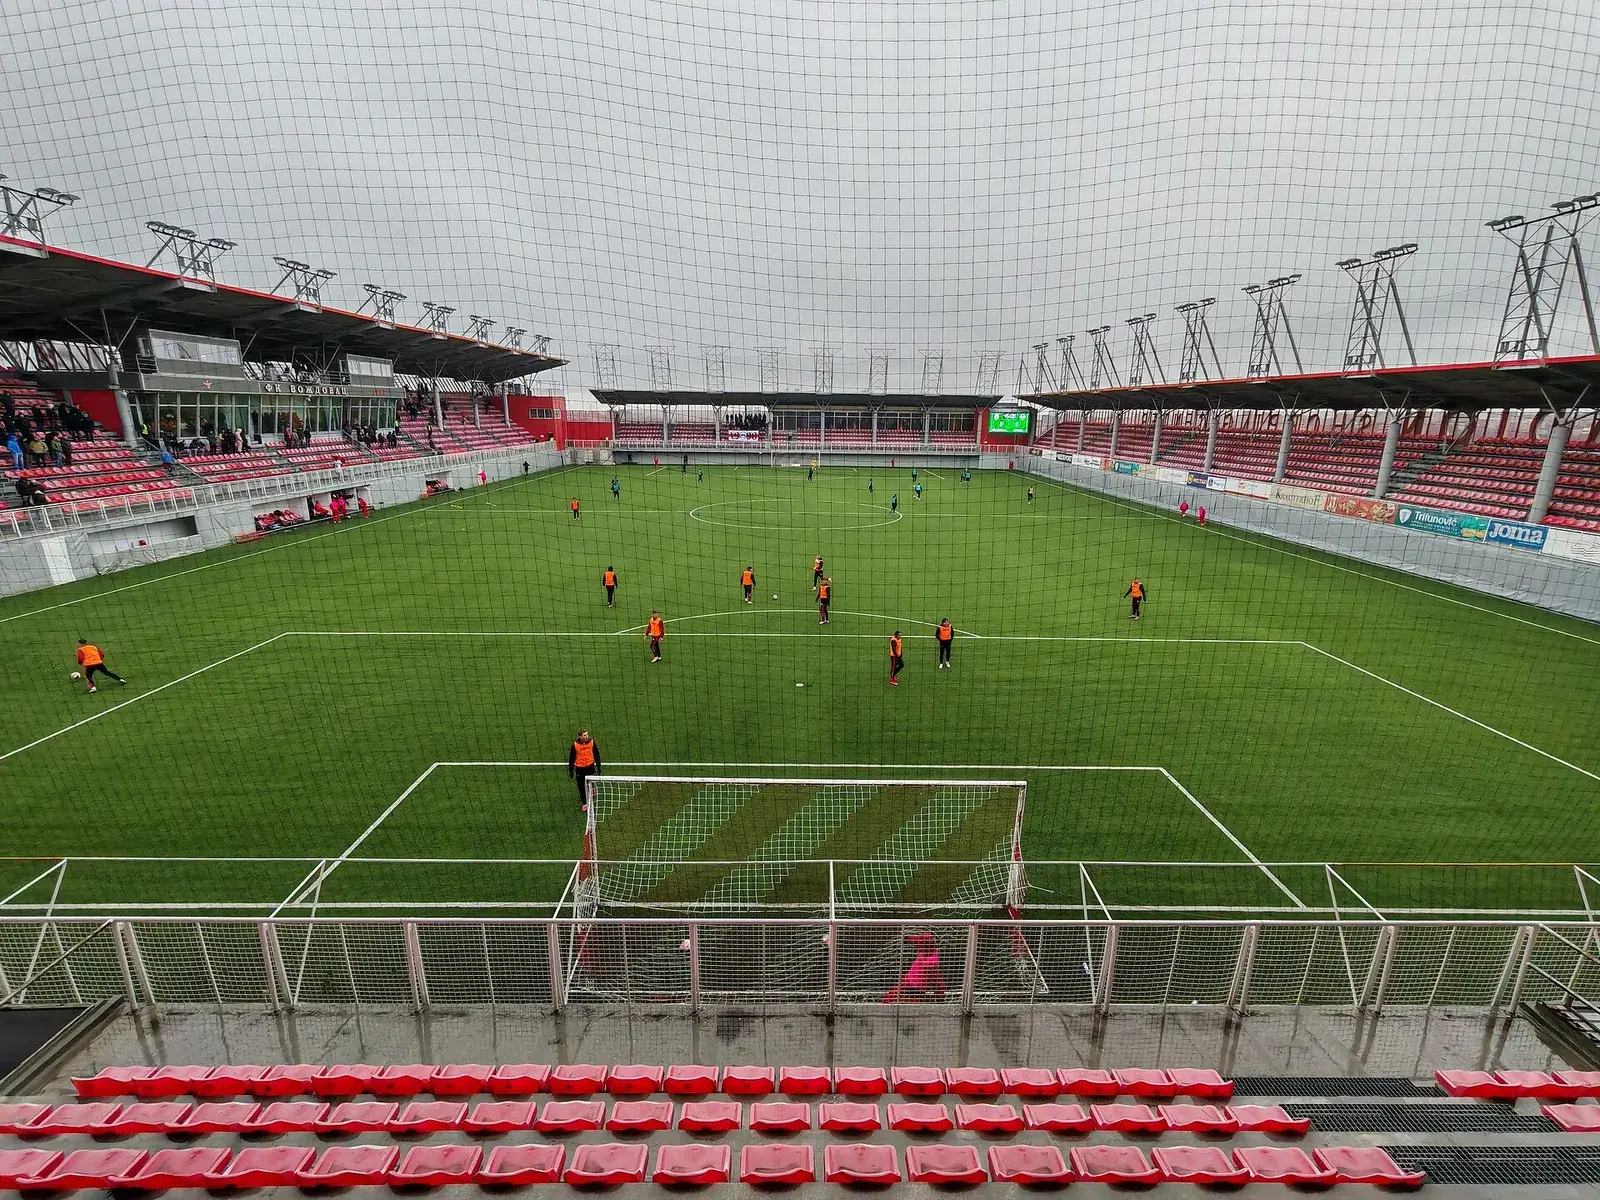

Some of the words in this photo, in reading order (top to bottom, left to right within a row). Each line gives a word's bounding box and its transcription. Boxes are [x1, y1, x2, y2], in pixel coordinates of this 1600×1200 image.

[264, 383, 282, 394] ФК
[290, 384, 349, 396] ВОЖДОВАЦ
[1415, 511, 1458, 527] Trifunović
